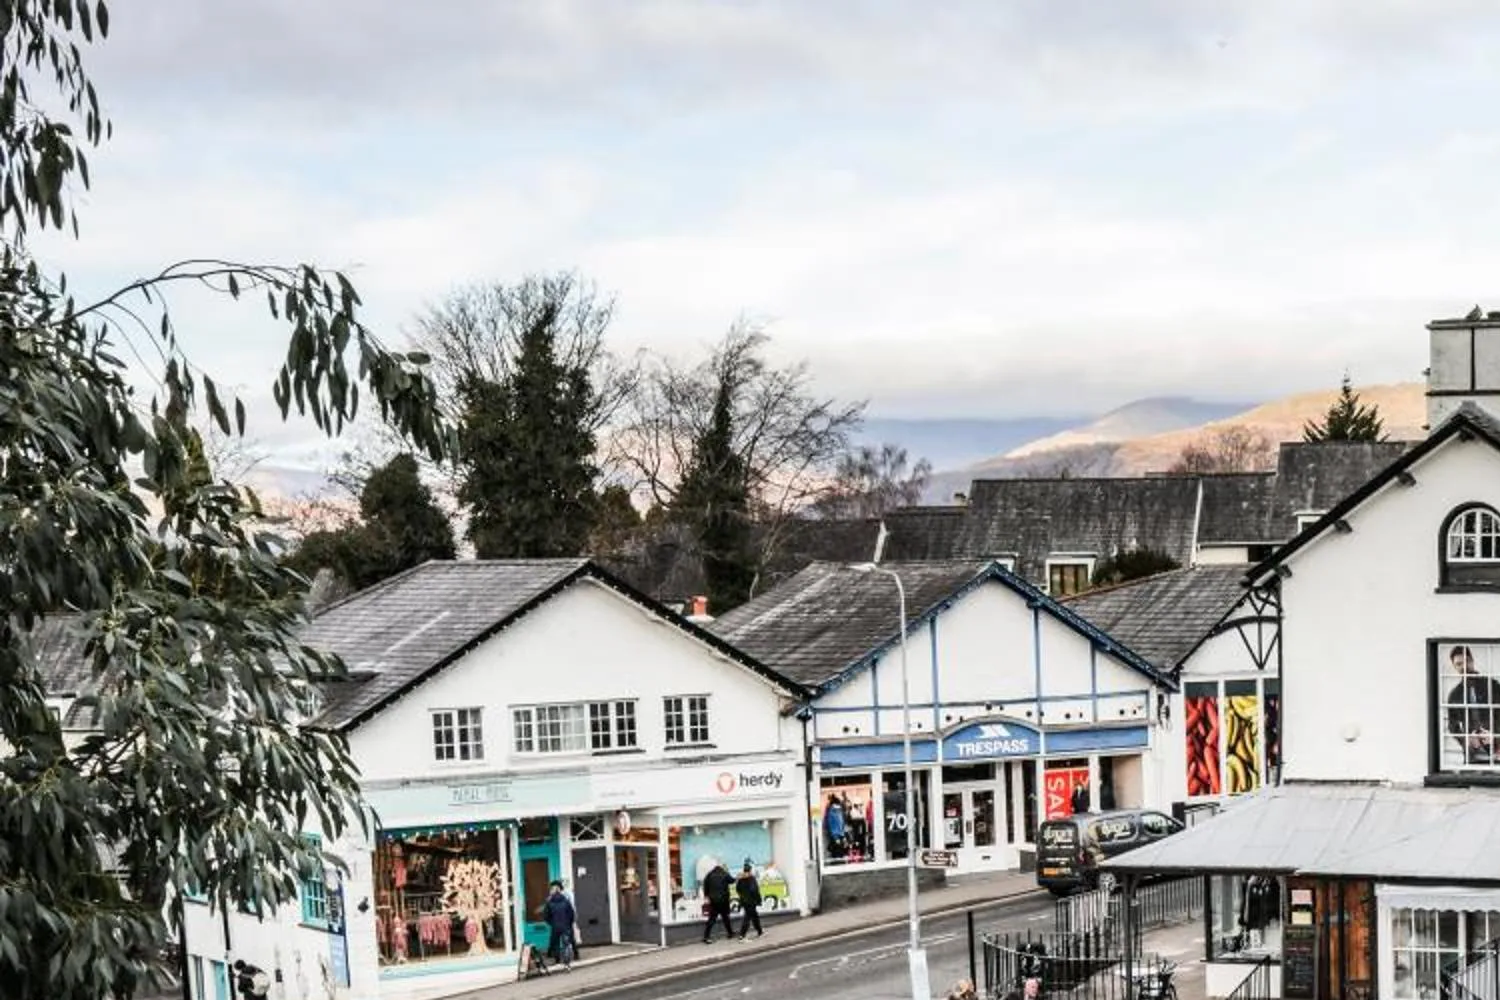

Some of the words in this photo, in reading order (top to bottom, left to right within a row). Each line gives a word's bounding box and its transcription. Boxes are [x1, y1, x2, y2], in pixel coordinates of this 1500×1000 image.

[957, 740, 1028, 757] TRESPASS
[739, 771, 783, 789] herdy
[1046, 777, 1066, 821] SAL
[886, 811, 916, 832] 70
